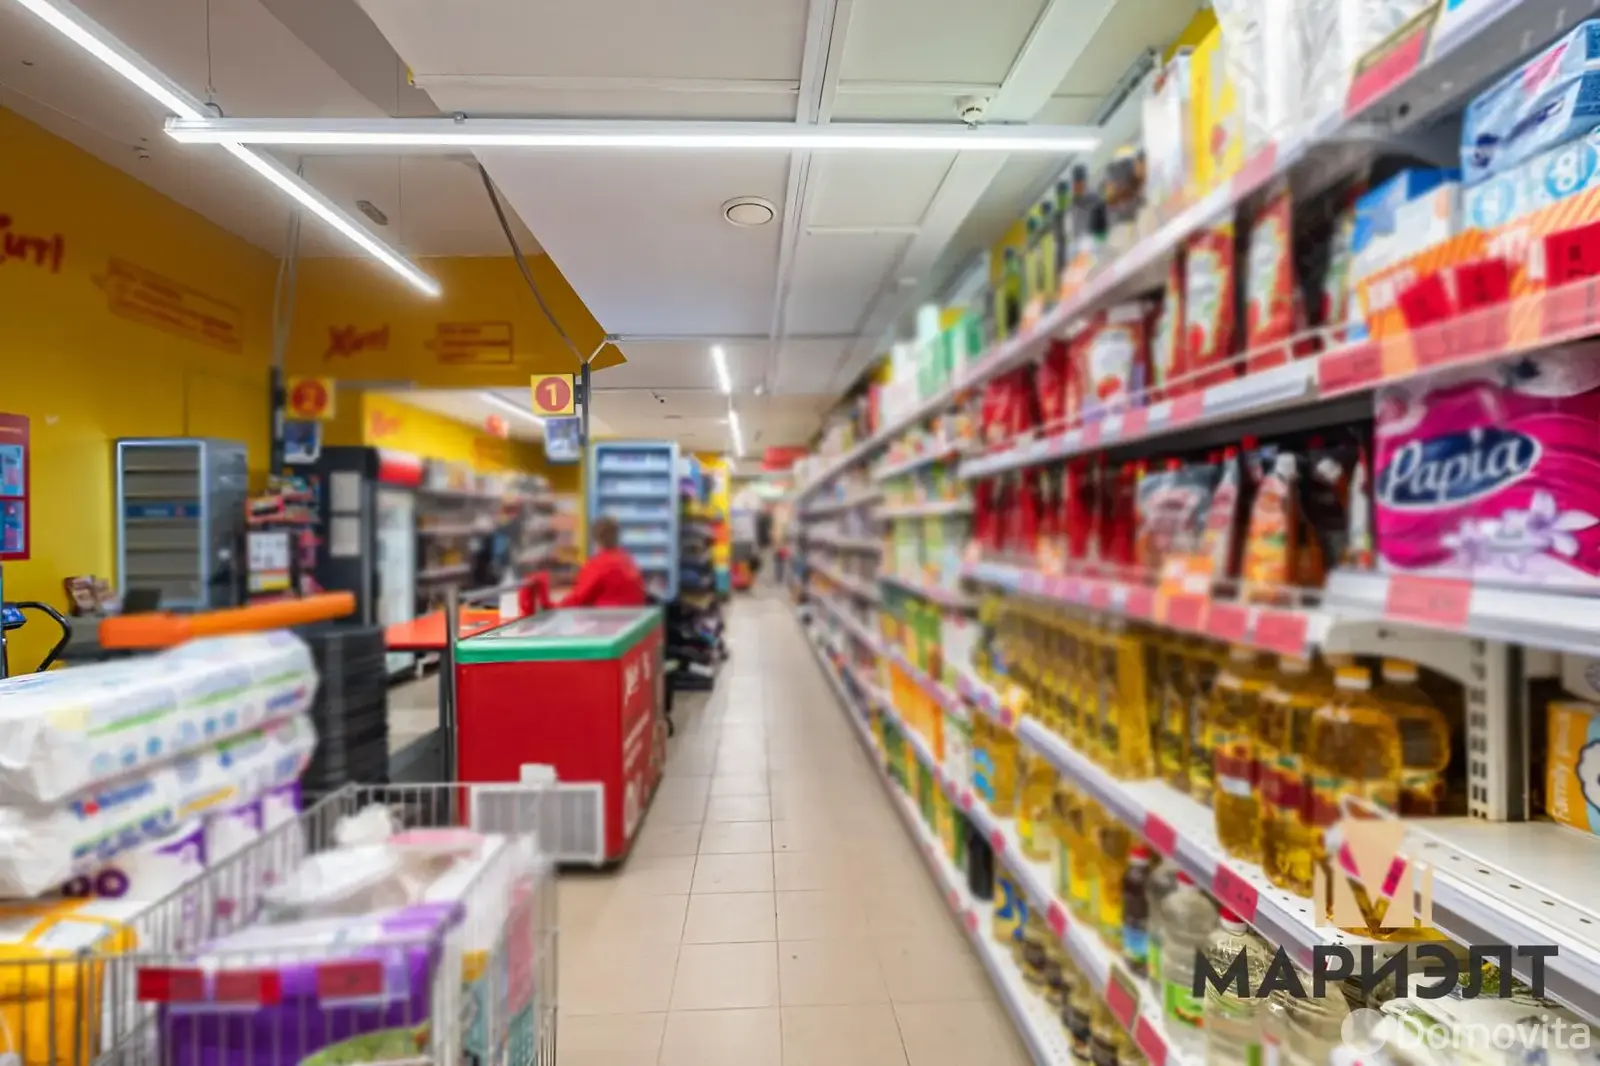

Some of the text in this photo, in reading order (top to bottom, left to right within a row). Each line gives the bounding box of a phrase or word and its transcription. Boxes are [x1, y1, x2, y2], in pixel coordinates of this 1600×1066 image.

[0, 212, 65, 274] ит!
[545, 383, 557, 406] 1
[1385, 427, 1527, 504] Papia
